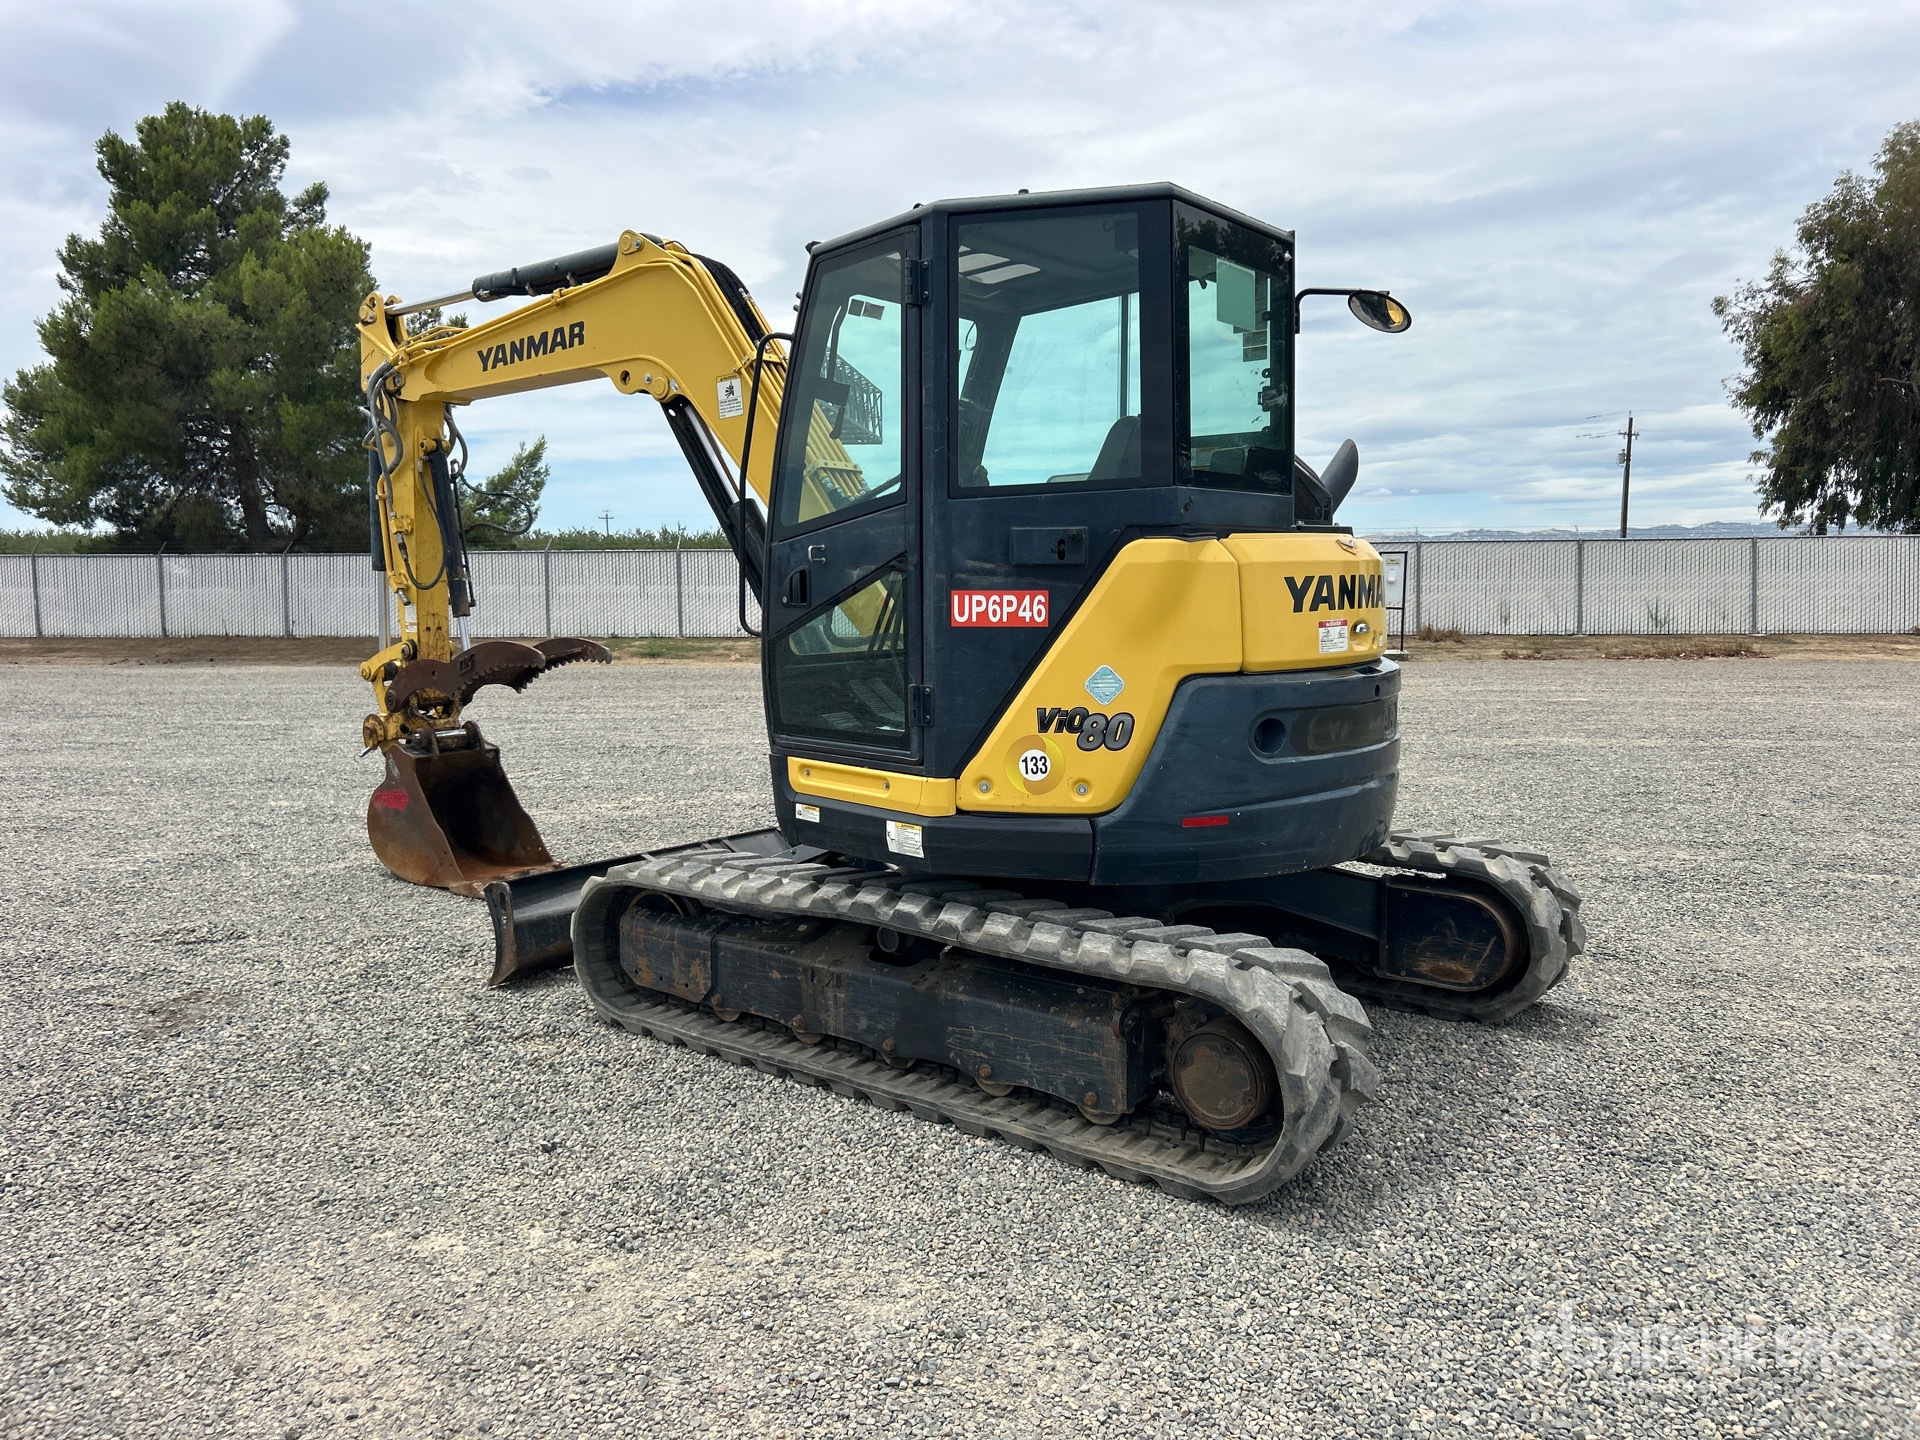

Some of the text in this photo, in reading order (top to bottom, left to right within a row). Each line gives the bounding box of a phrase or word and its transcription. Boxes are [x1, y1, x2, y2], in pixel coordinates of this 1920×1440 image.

[477, 321, 585, 373] YANMAR
[953, 594, 1046, 623] UP6P46
[1021, 755, 1048, 775] 133
